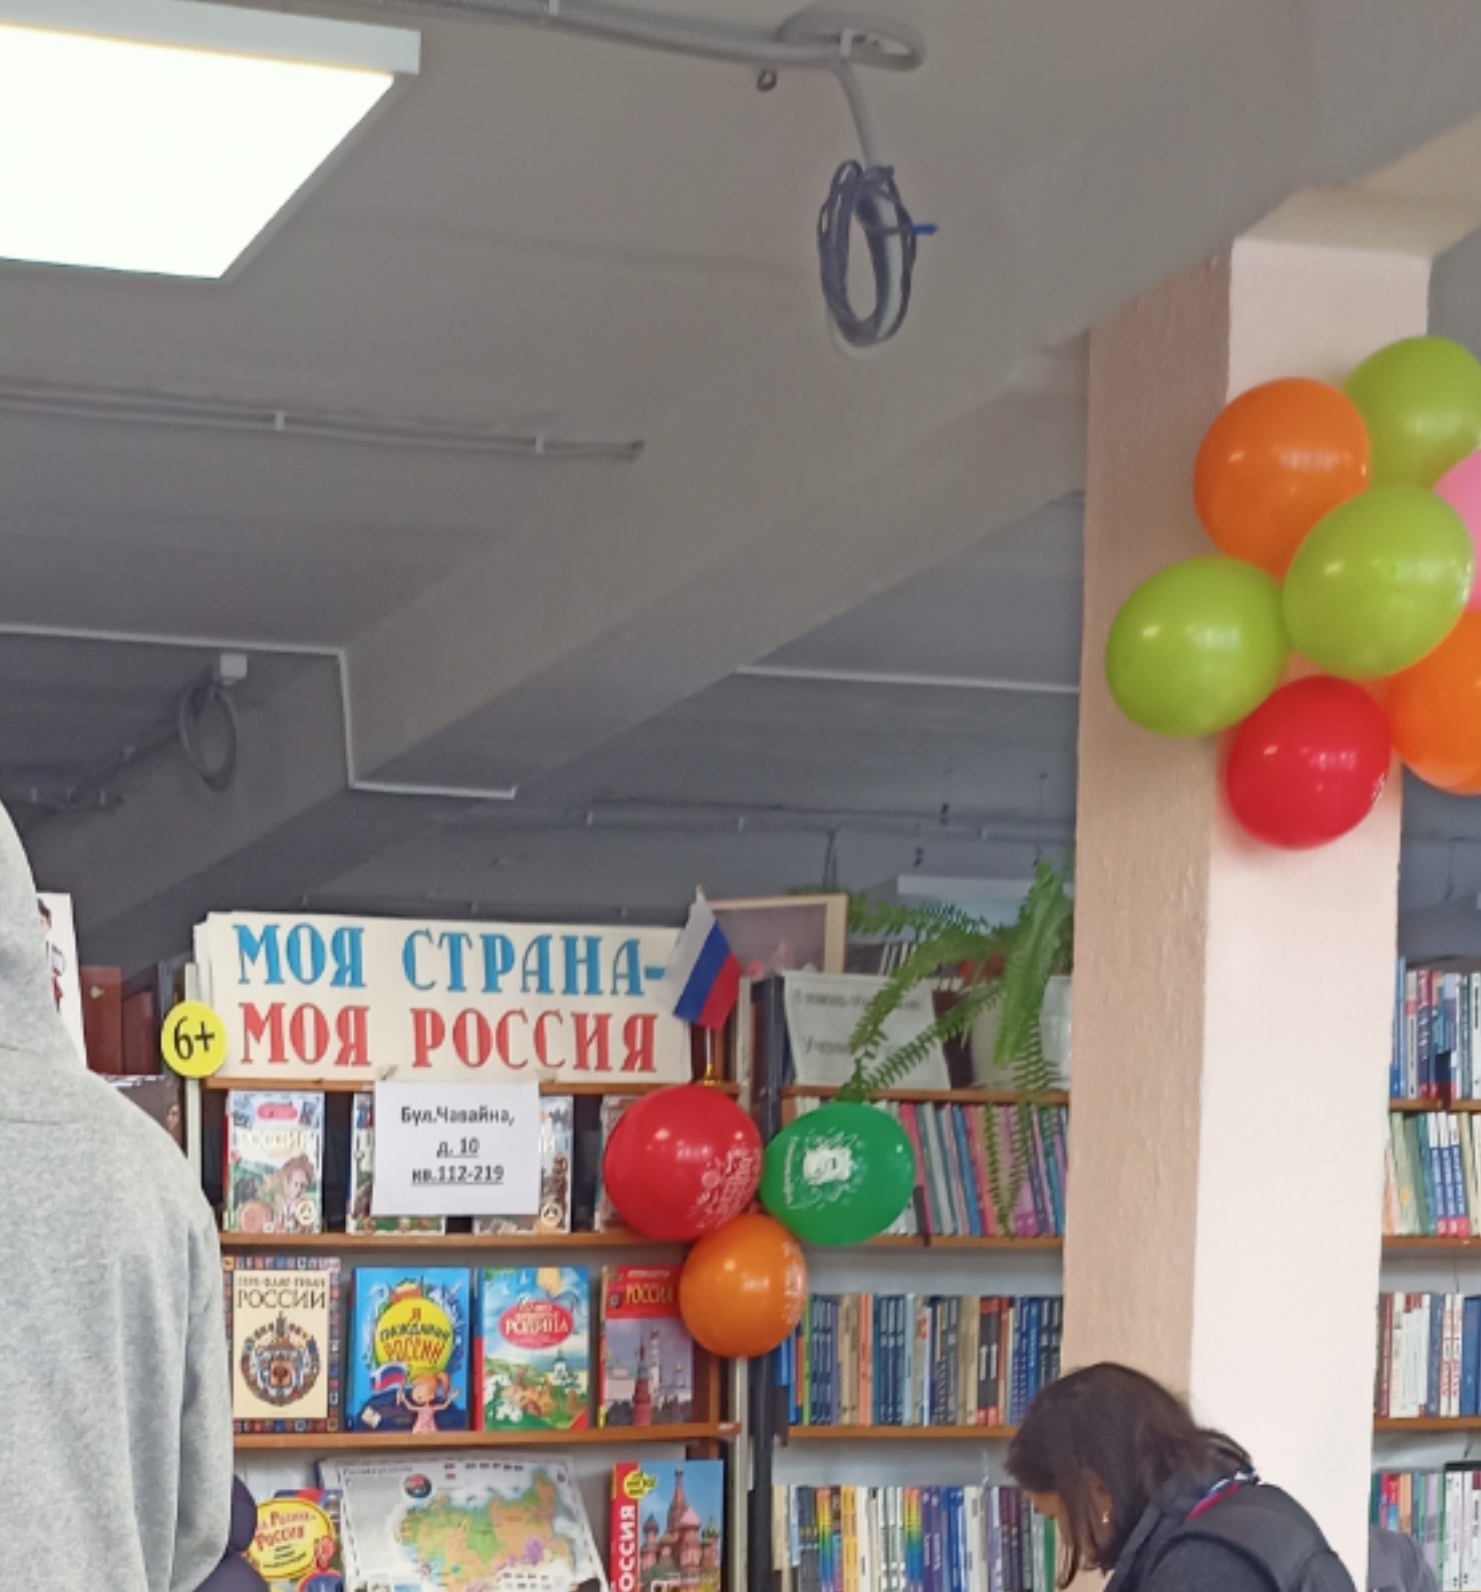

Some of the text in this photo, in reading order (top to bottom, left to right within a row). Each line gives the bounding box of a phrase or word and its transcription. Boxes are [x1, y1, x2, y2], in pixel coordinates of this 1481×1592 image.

[232, 922, 666, 996] МОЯ СТРАНА-
[173, 1016, 215, 1060] 6+
[239, 1002, 658, 1073] МОЯ РОССИЯ
[401, 1105, 515, 1127] Бул.Чавайна,
[460, 1137, 480, 1154] 10
[411, 1164, 505, 1185] кв.112-219
[237, 1288, 326, 1310] РОССИИ
